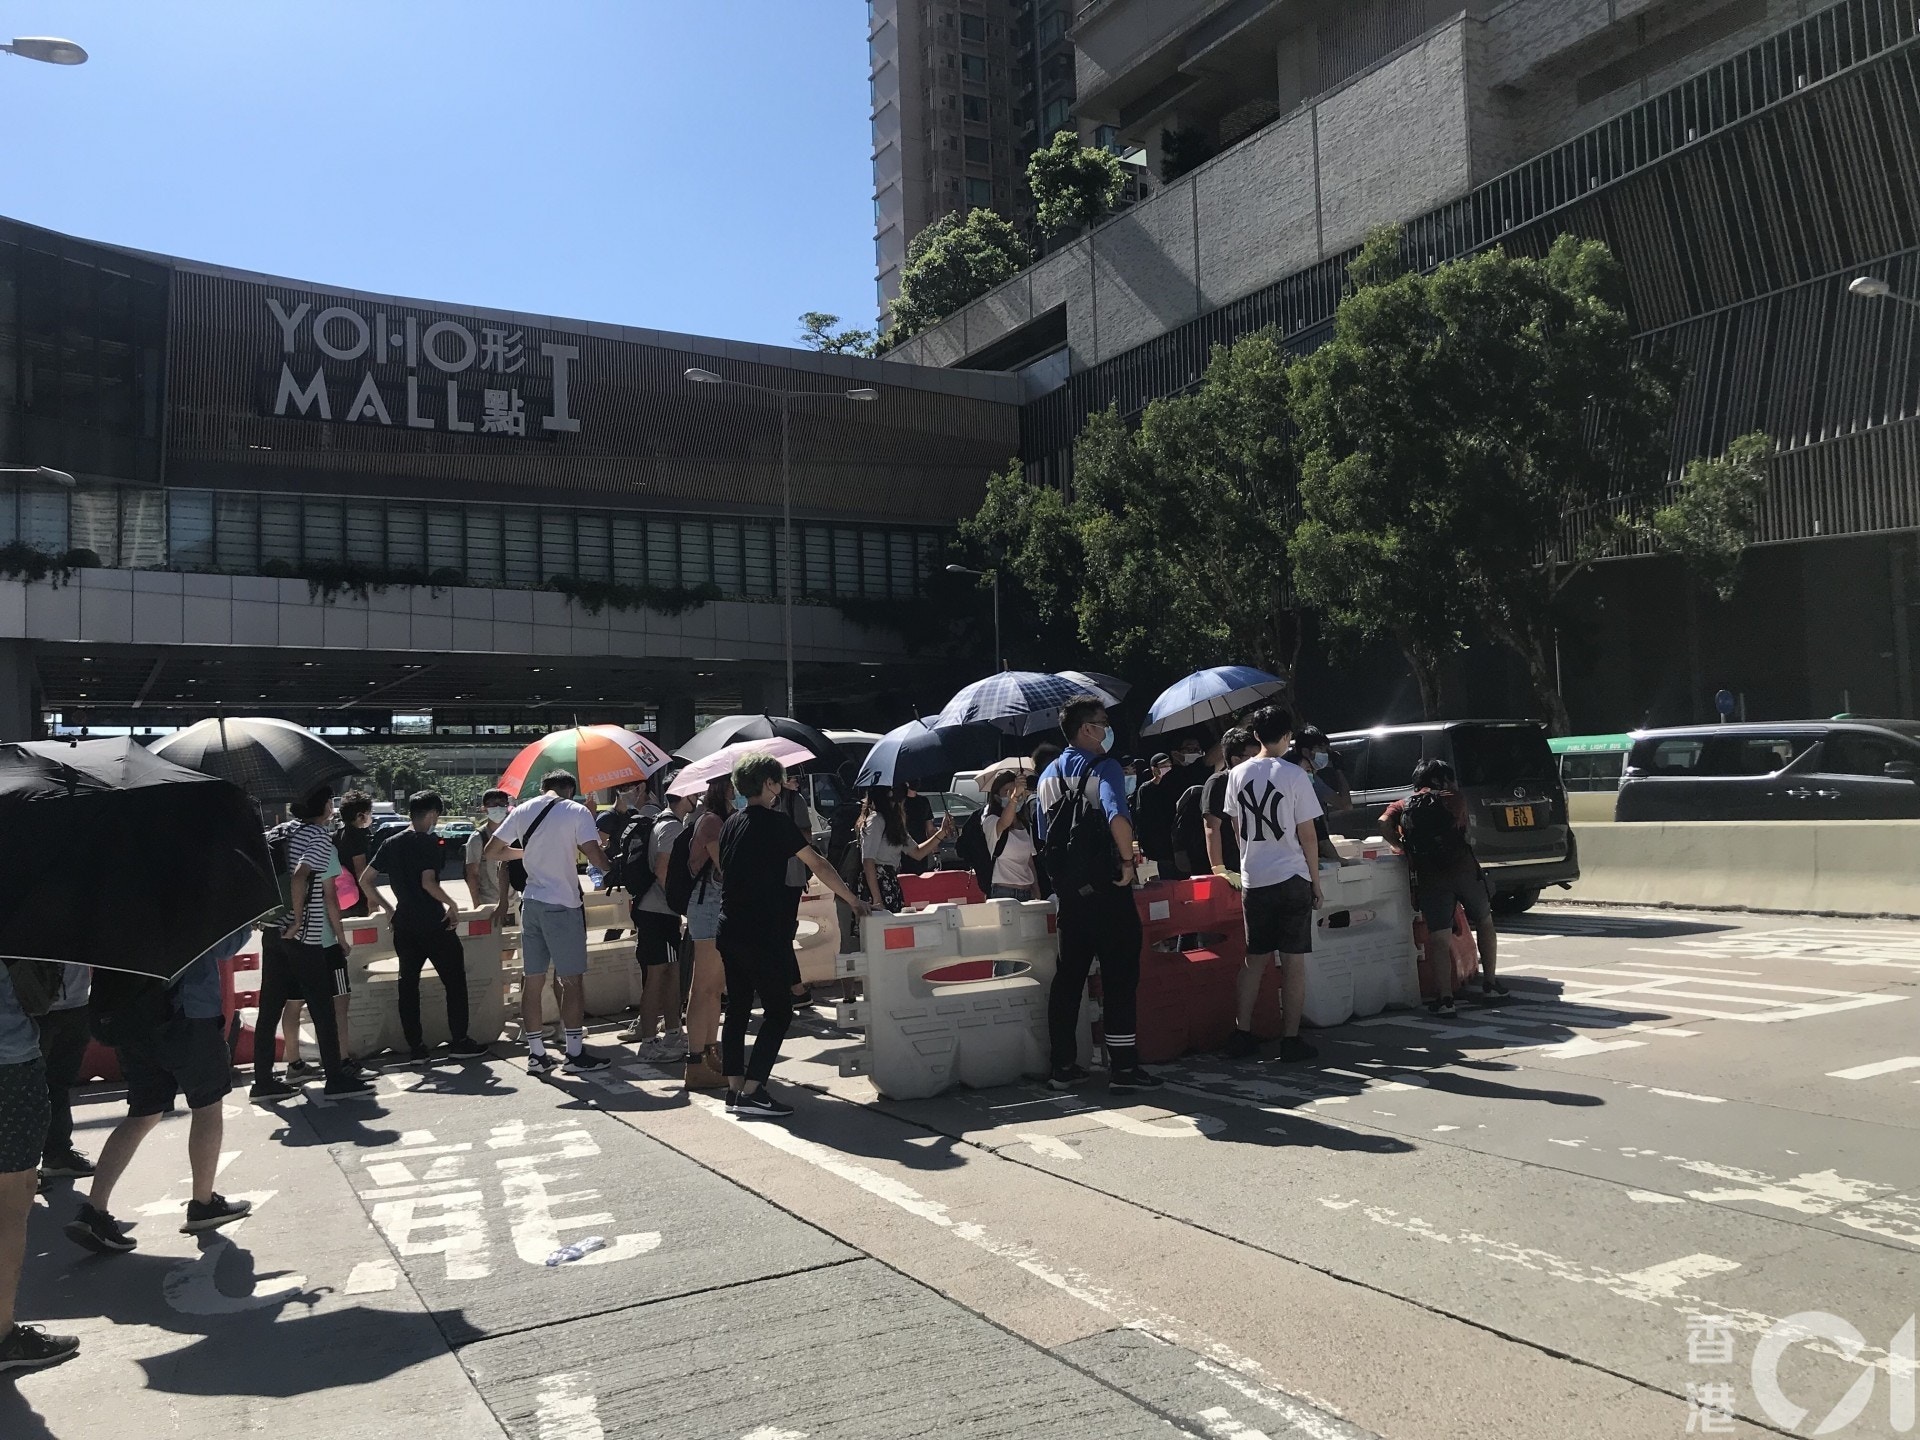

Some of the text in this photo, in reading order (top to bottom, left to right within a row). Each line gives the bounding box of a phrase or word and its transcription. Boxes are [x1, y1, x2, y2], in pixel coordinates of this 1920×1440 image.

[266, 299, 477, 373] YOHO
[274, 361, 475, 433] MALL
[1566, 743, 1586, 752] PUBLIC
[1590, 742, 1608, 751] LIGHT
[1609, 742, 1622, 750] BUS
[1237, 779, 1285, 842] NY
[1513, 807, 1527, 817] EN
[1513, 816, 1528, 826] 819
